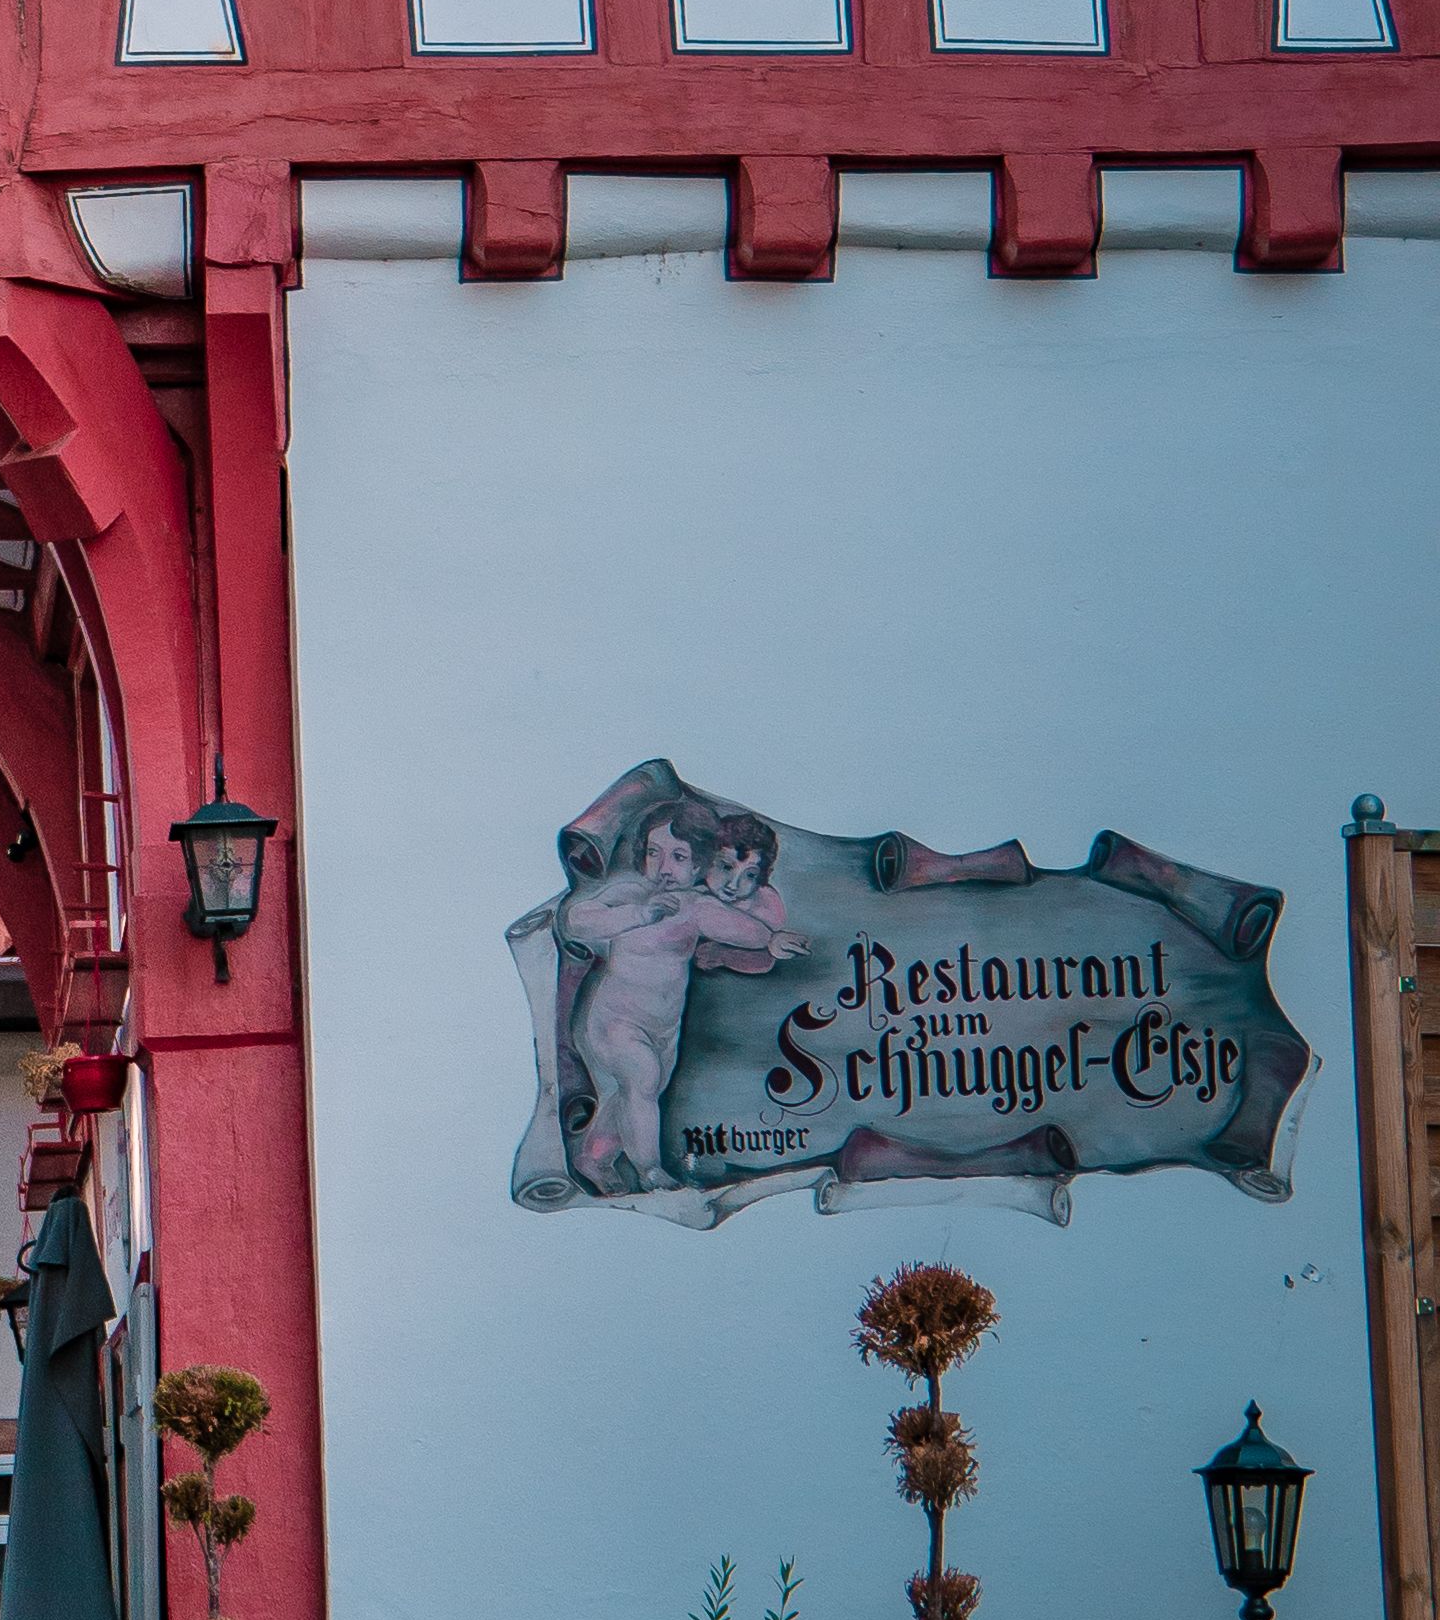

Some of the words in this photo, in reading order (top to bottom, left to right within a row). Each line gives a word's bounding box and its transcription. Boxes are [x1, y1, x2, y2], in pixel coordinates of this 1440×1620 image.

[837, 931, 1171, 1030] Restaurant
[760, 1001, 1241, 1125] Schnuggel-Elsje
[906, 1011, 993, 1051] zum
[682, 1123, 811, 1157] Bitburger
